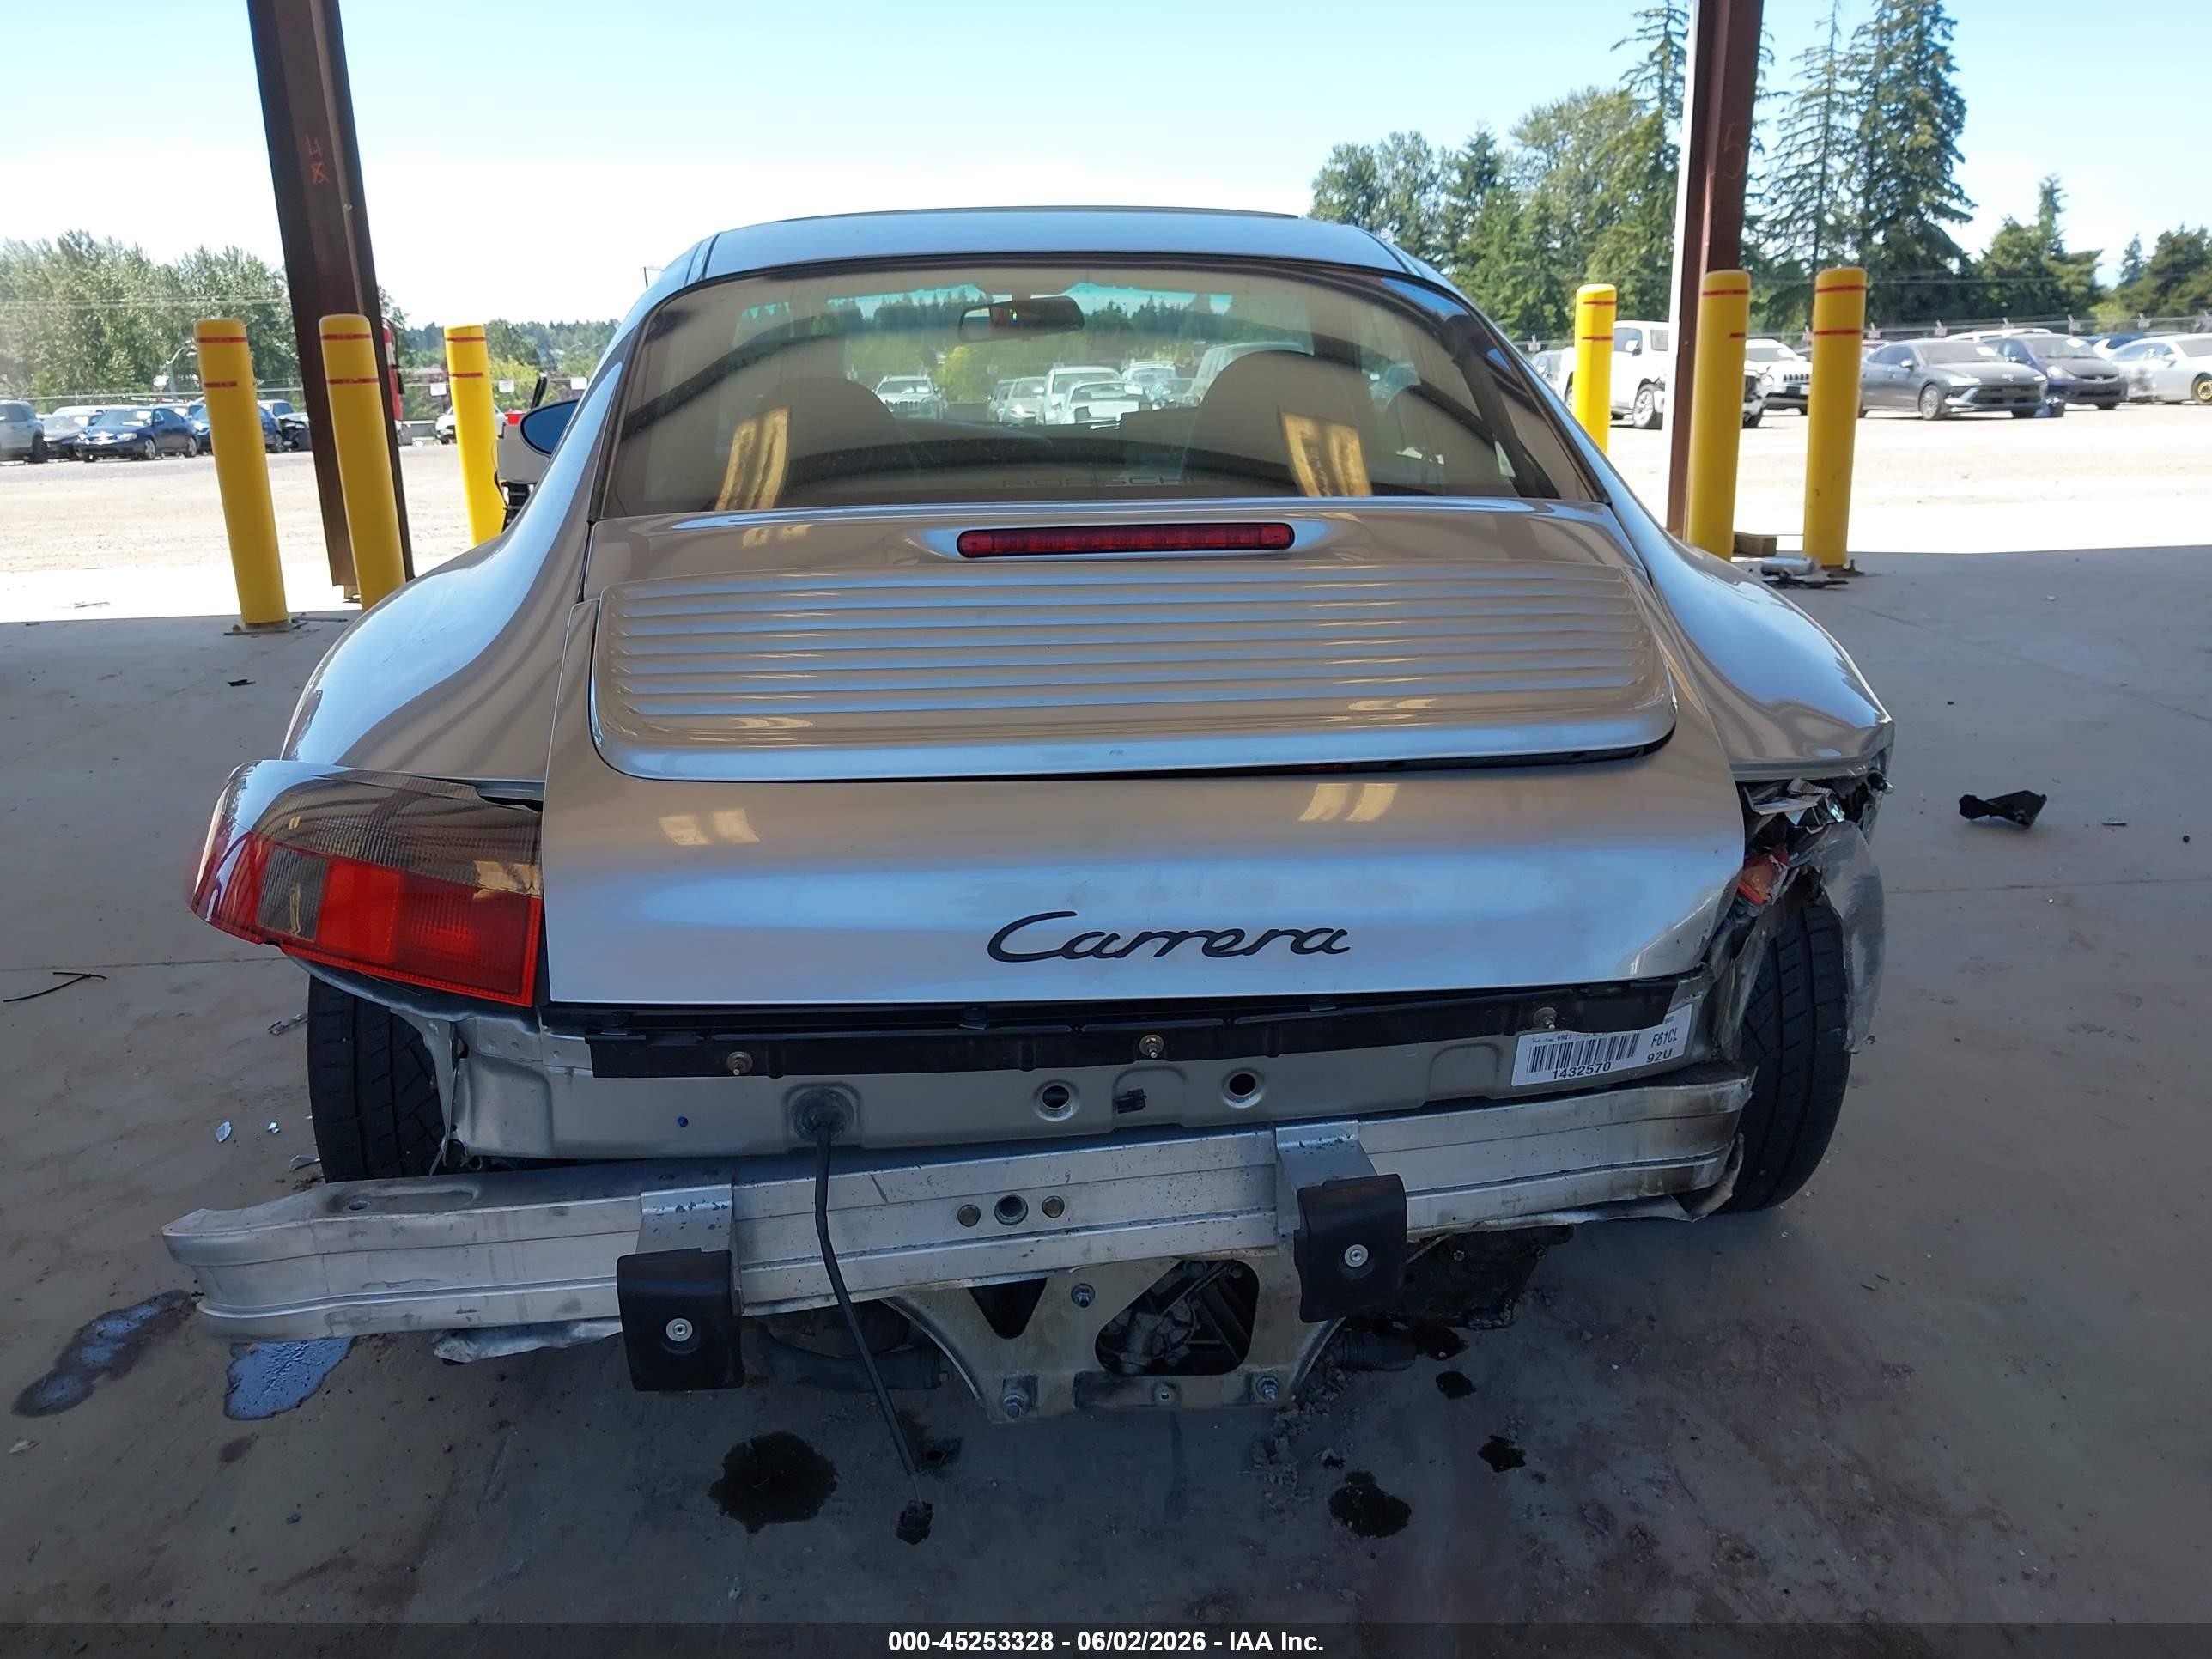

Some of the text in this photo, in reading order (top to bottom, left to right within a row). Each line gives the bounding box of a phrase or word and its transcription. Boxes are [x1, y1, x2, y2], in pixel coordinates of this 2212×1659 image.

[987, 910, 1352, 963] Carrera
[1650, 1027, 1678, 1048] F61CL
[1646, 1048, 1673, 1063] 92U
[1553, 1062, 1611, 1079] 1432570
